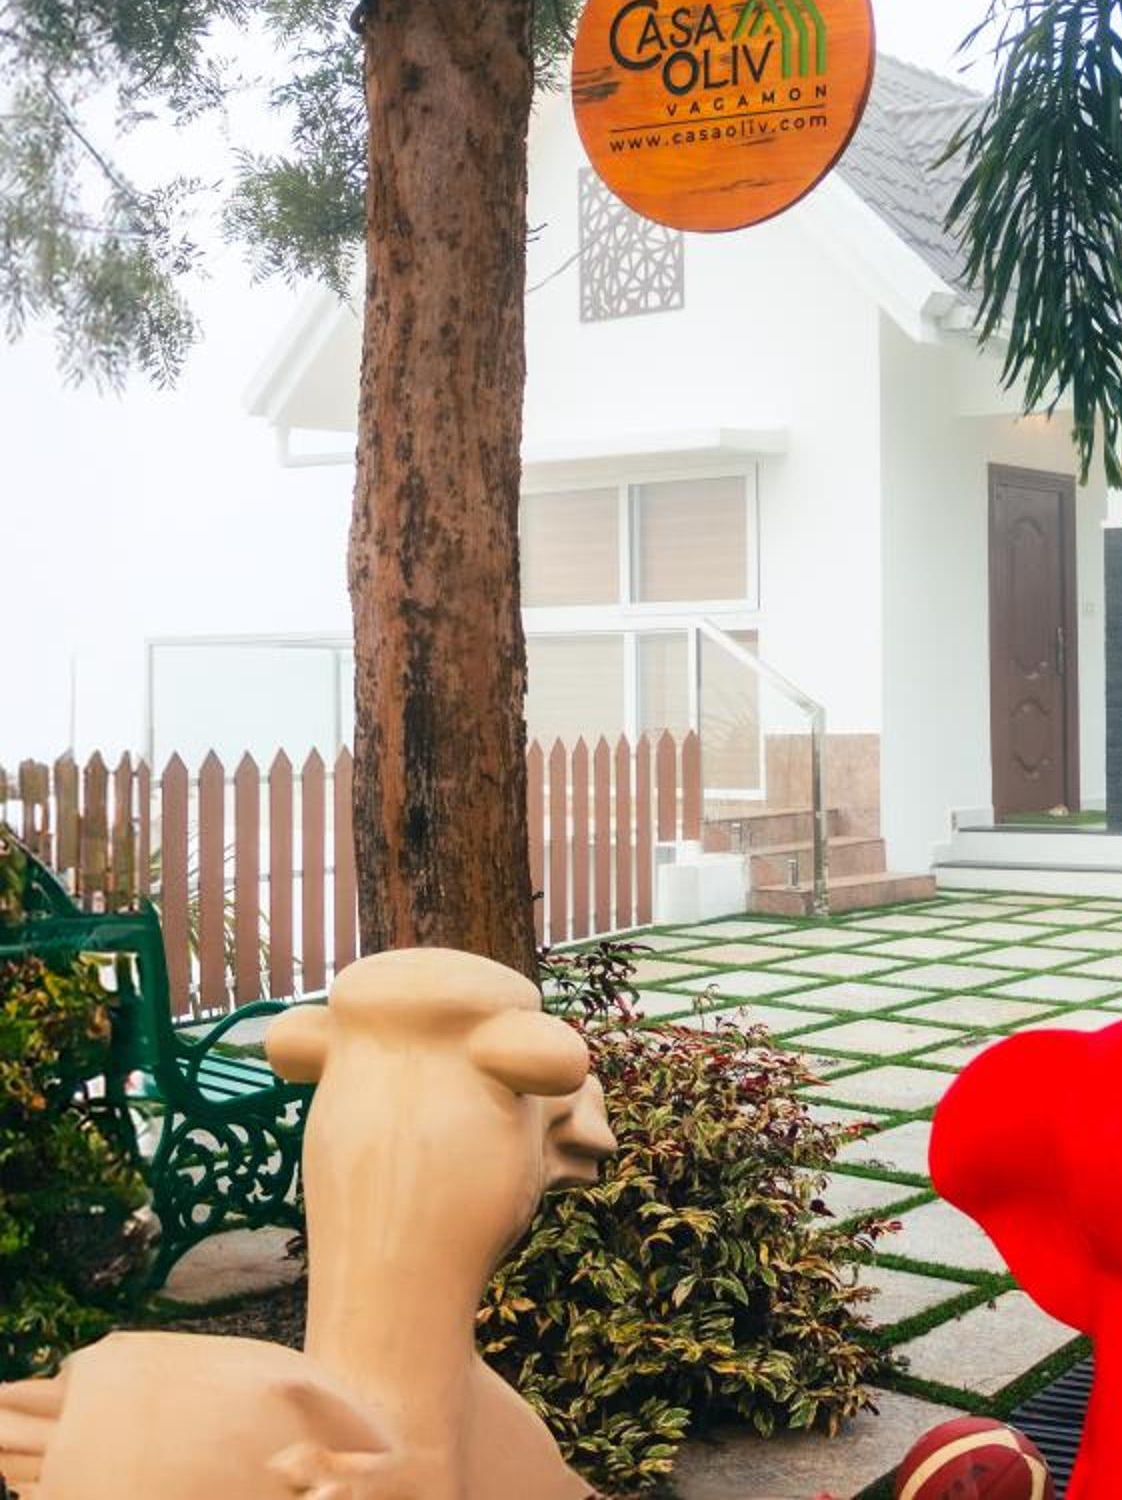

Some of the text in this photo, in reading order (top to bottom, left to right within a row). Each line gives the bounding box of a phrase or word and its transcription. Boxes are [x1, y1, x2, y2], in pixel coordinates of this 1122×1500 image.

[662, 40, 775, 95] OLIV
[667, 85, 827, 116] VAGAMON
[610, 114, 827, 152] www.casaoliv.com
